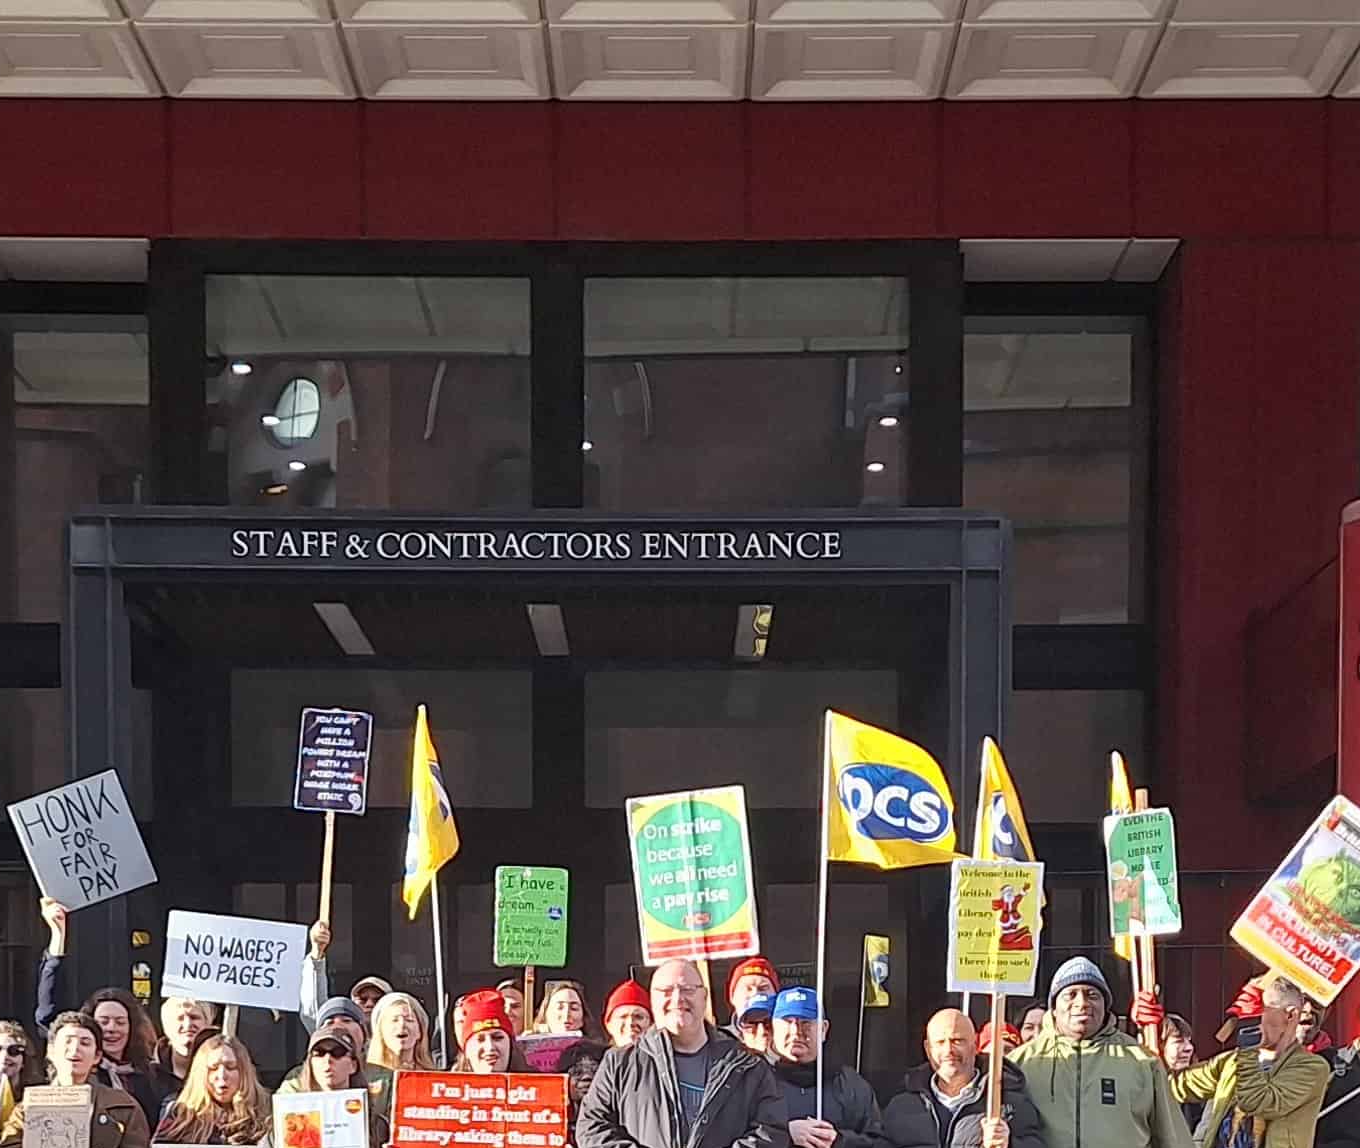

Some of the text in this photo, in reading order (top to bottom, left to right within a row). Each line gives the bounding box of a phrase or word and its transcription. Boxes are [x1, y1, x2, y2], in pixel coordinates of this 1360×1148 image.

[232, 531, 841, 559] STAFF & CONTRACTORS ENTRANCE
[18, 779, 120, 846] HONK
[60, 827, 99, 852] FOR
[643, 816, 723, 840] On strike
[1127, 829, 1161, 842] BRITISH
[60, 842, 118, 877] FAIR
[646, 842, 714, 864] because
[1127, 844, 1165, 858] LIBRARY
[78, 863, 120, 901] PAY
[520, 873, 555, 890] have
[649, 859, 737, 887] we all need
[959, 867, 1002, 879] Welcome
[1014, 869, 1031, 879] the
[652, 887, 730, 912] a pay rise
[958, 908, 994, 921] Library
[957, 930, 974, 940] pay
[185, 933, 288, 965] NO WAGES?
[996, 958, 1009, 967] no
[1009, 957, 1031, 968] such
[182, 961, 281, 989] NO PAGES.
[431, 1082, 538, 1105] I'm just a girl
[403, 1105, 562, 1124] standing in front of a
[397, 1126, 564, 1148] library asking them to
